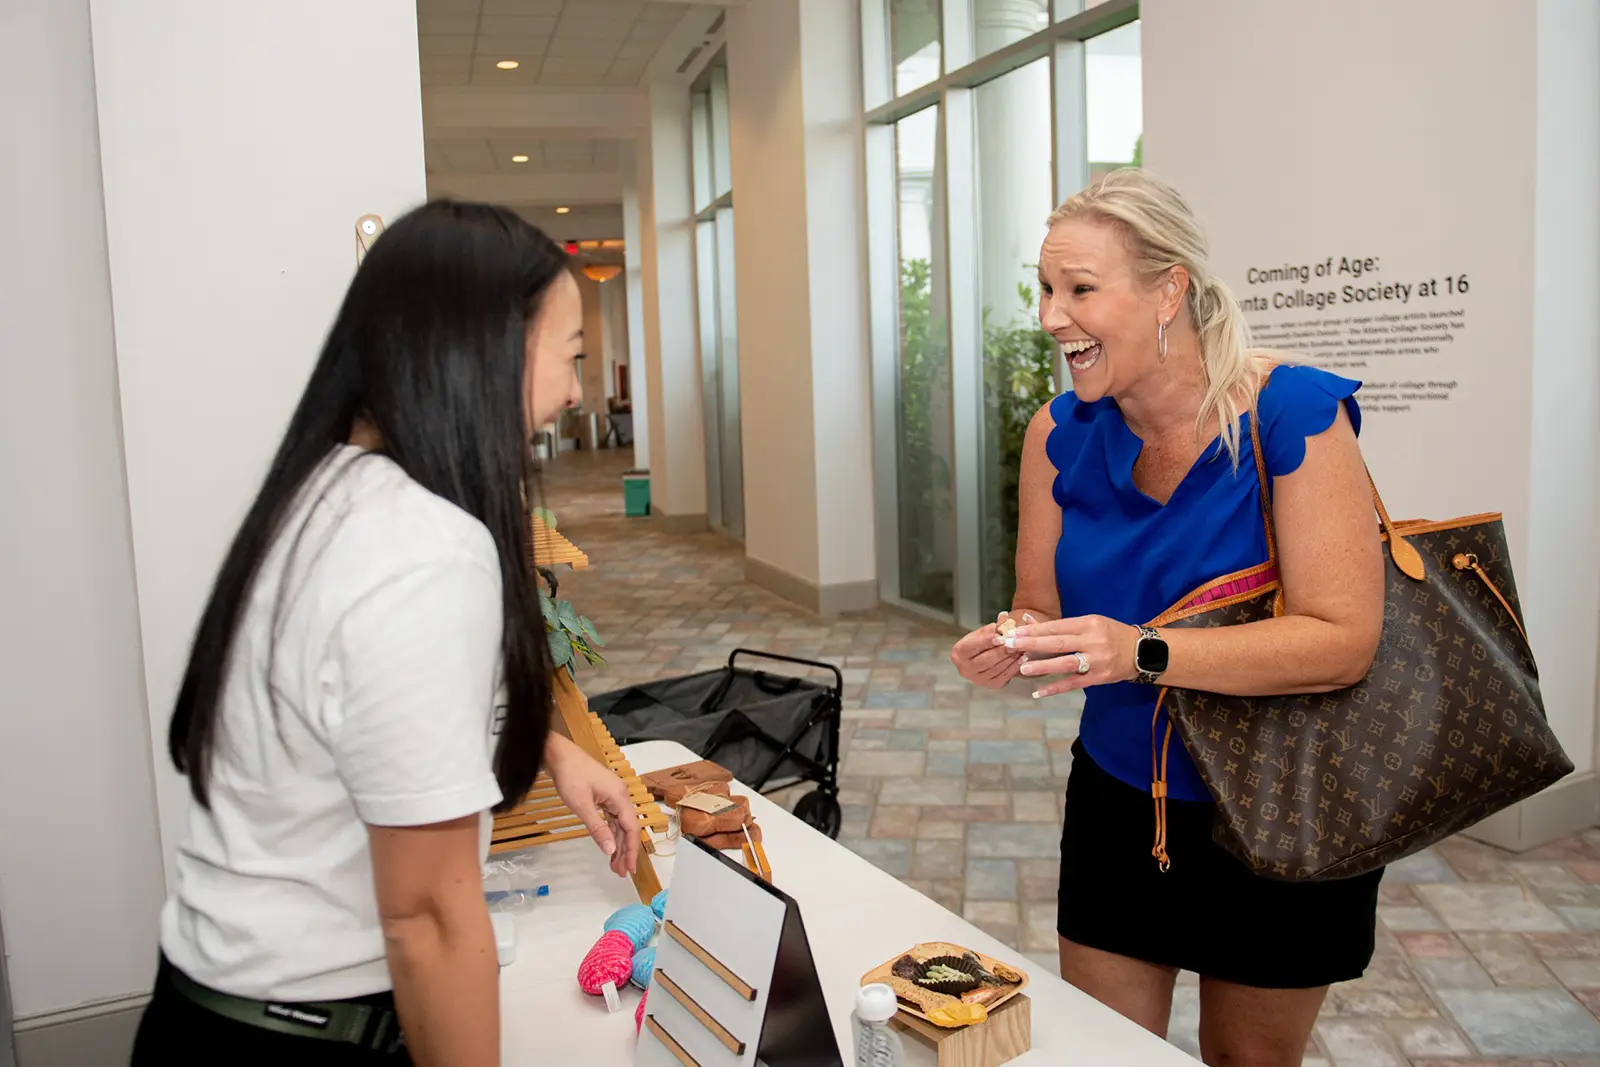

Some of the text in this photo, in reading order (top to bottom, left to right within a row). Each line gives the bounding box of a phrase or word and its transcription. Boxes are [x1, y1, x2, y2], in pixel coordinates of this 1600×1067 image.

[1247, 256, 1379, 284] Coming of Age:
[1273, 288, 1337, 311] Collage
[1342, 281, 1412, 304] Society
[1418, 279, 1438, 297] at
[1445, 274, 1470, 295] 16
[1391, 324, 1418, 333] Collage
[1420, 322, 1448, 331] Society
